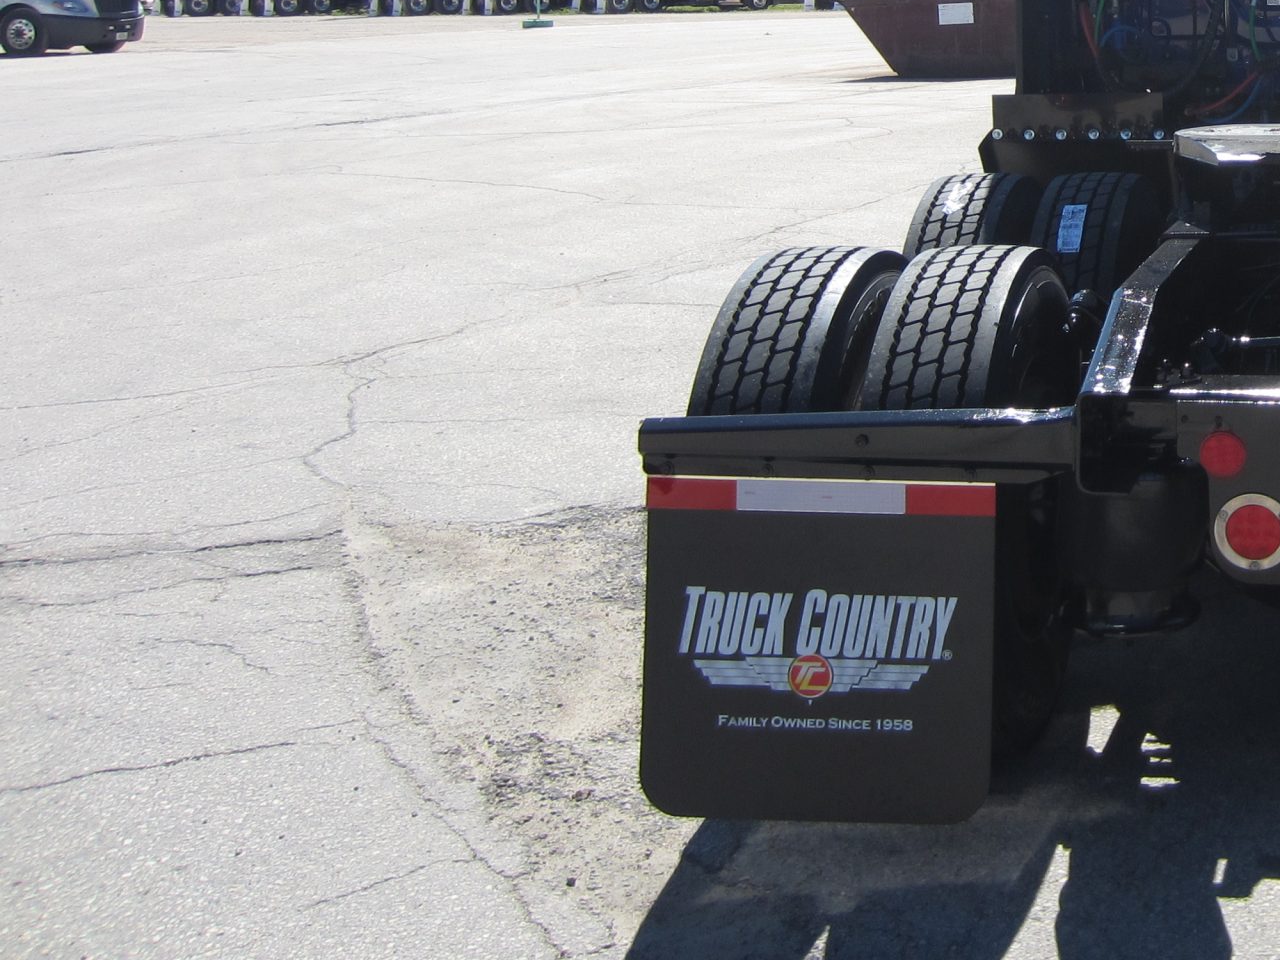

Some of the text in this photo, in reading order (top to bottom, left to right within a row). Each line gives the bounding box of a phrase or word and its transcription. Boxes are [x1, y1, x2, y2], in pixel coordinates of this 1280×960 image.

[679, 585, 794, 656] TRUCK
[718, 714, 914, 731] FAMILY OWNED SINCE 1958
